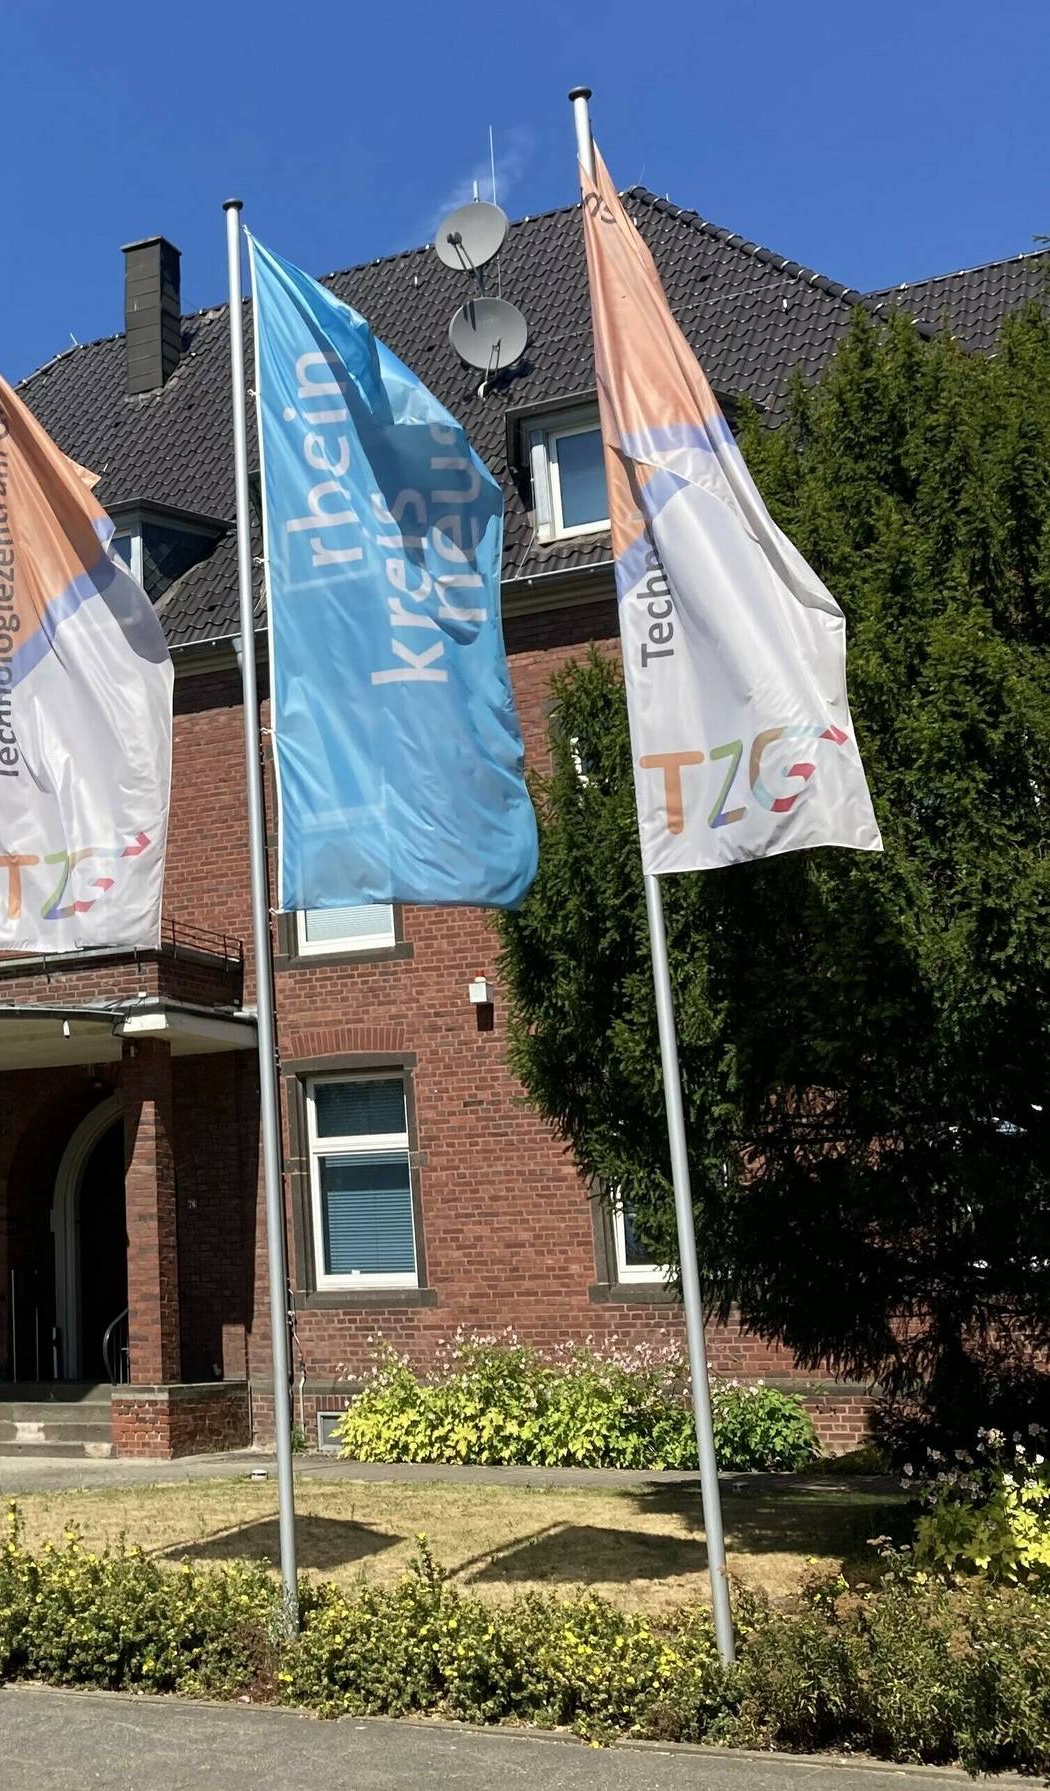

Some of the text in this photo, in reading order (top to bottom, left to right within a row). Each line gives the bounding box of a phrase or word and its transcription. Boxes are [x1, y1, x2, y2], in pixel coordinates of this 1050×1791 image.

[283, 351, 363, 567] rhein
[361, 487, 449, 686] kreis
[636, 526, 675, 668] Techn
